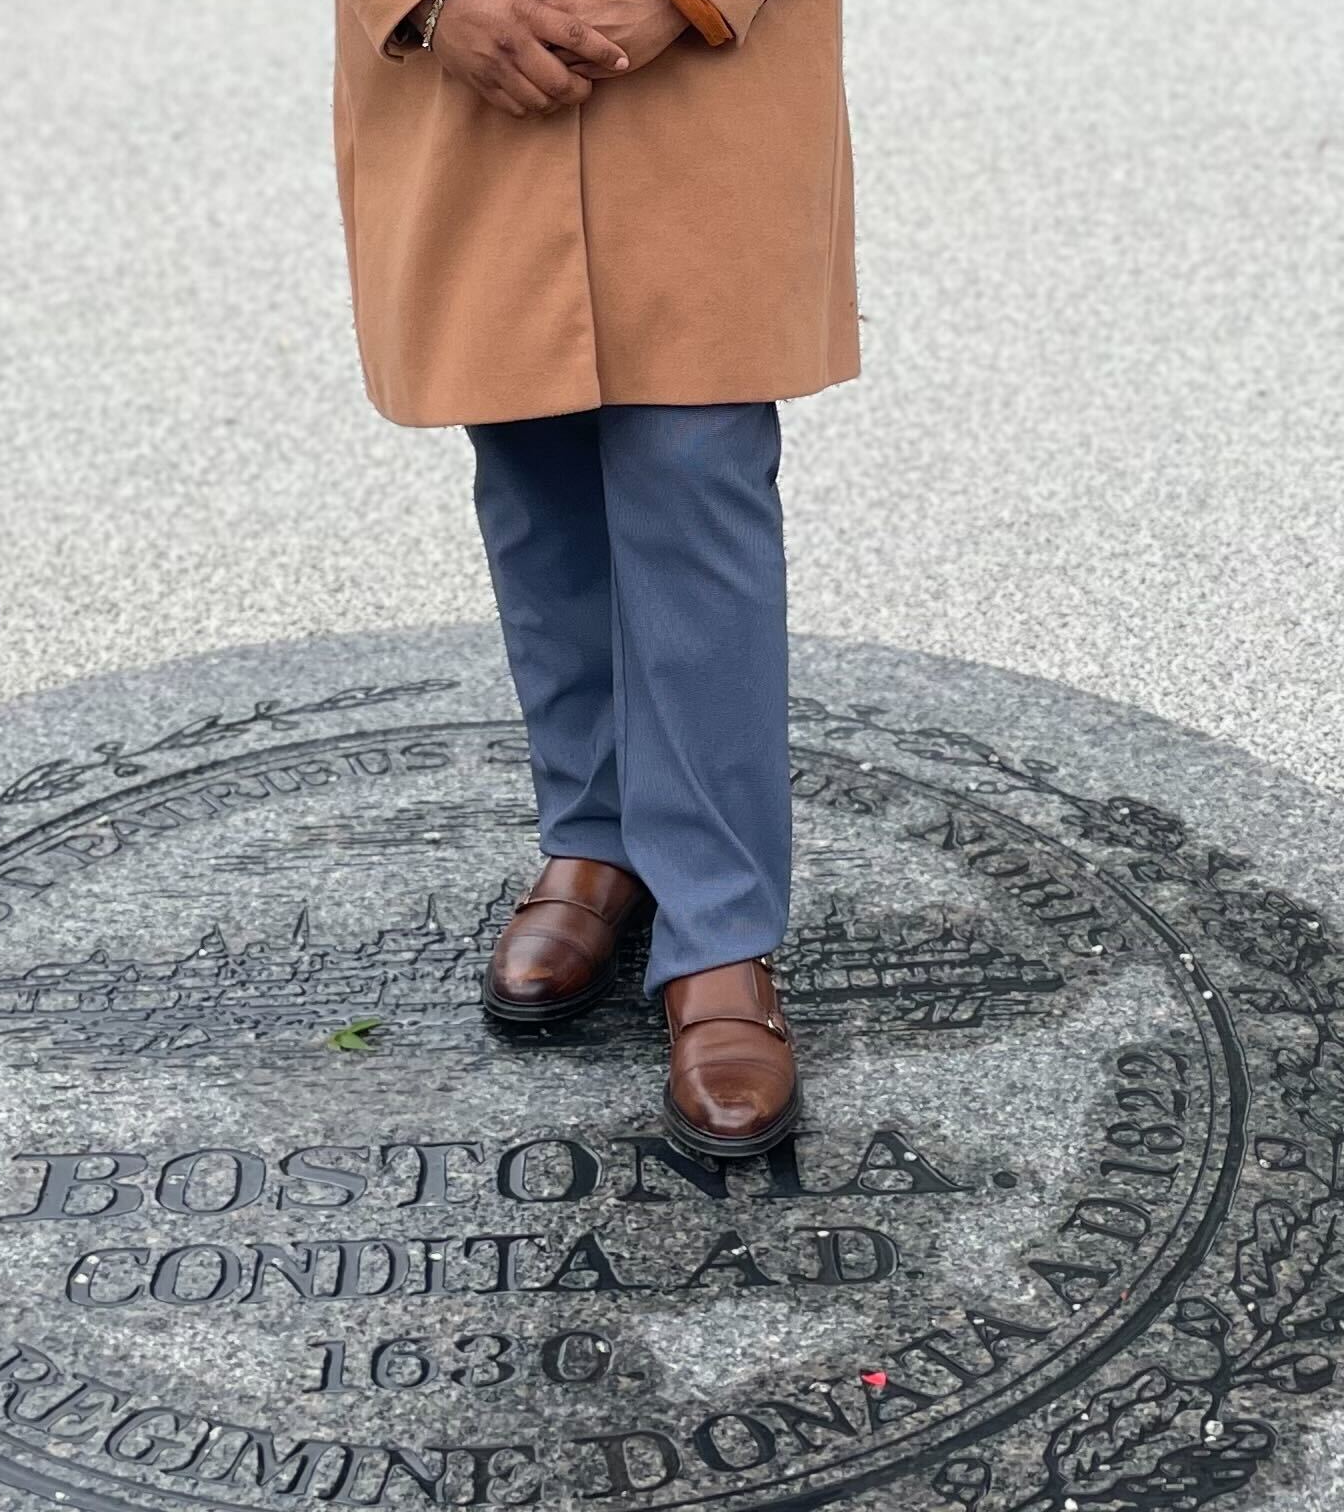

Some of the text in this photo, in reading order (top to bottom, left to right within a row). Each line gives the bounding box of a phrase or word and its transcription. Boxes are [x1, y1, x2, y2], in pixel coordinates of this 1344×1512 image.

[38, 742, 451, 870] PATRIBUS
[905, 812, 1134, 956] NOBIS
[64, 1232, 660, 1309] CONDITA
[562, 1309, 1057, 1500] DONATA
